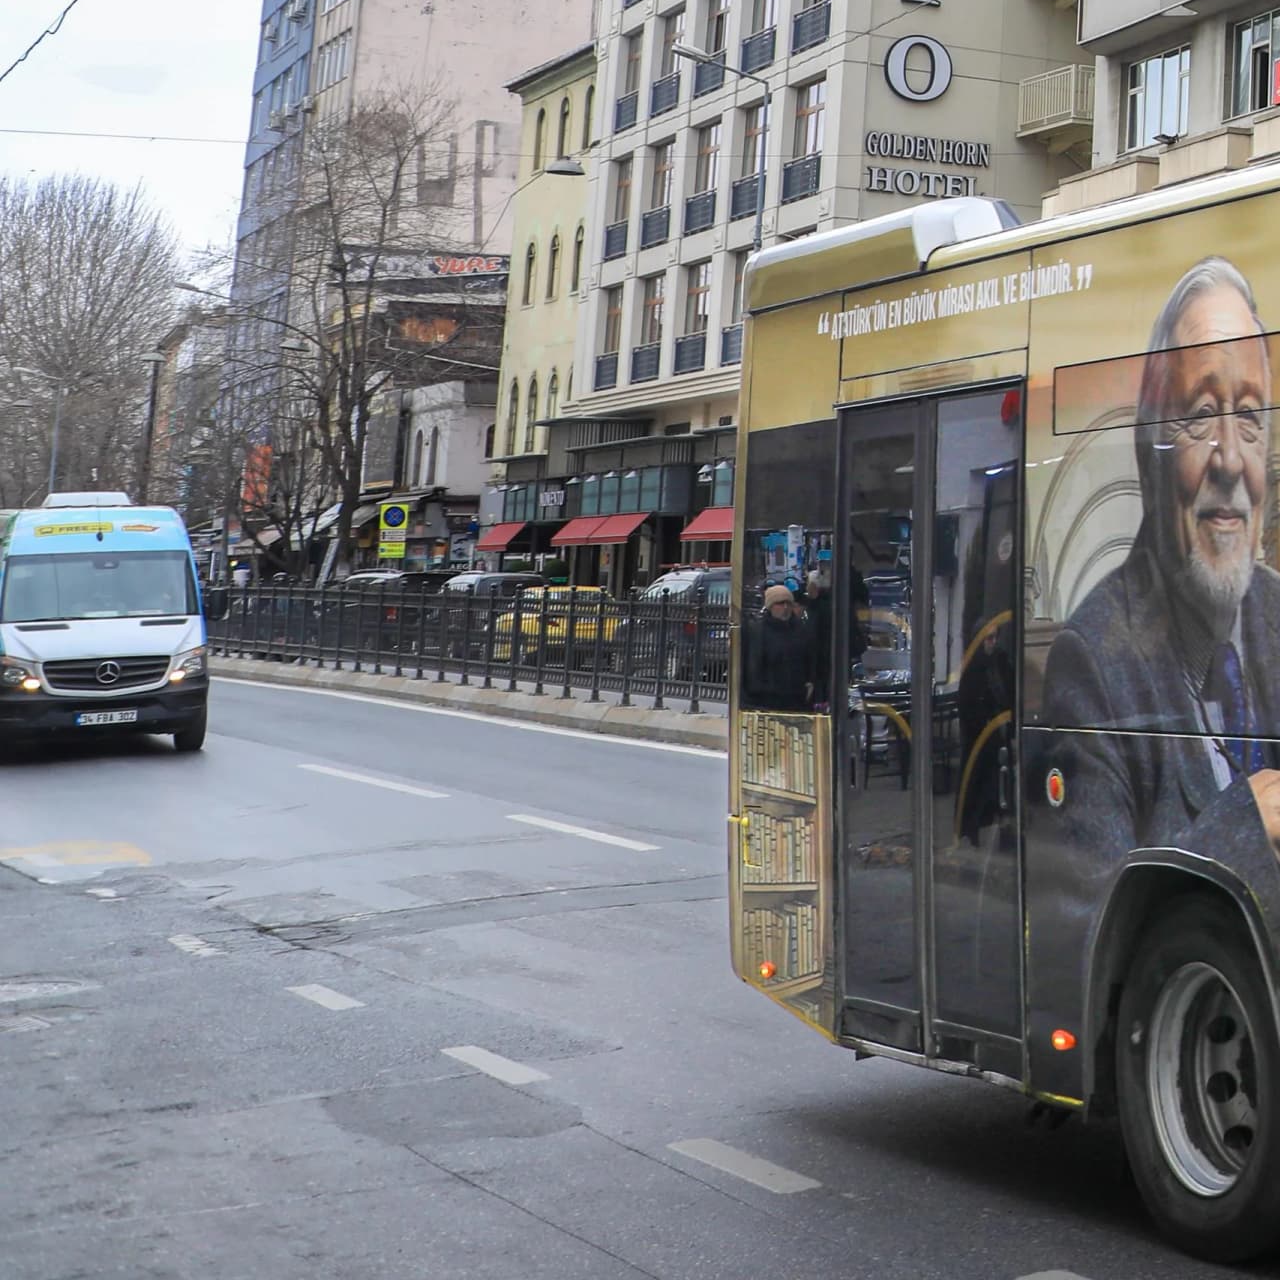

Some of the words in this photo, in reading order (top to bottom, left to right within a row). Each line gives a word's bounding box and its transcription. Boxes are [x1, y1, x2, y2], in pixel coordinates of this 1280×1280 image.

[866, 130, 937, 163] GOLDEN
[940, 139, 991, 168] HORN
[866, 166, 984, 199] HOTEL
[888, 299, 901, 329] EN
[903, 289, 936, 326] BÜYÜK
[937, 283, 975, 319] MİRASI
[975, 278, 1000, 310] AKIL
[1003, 273, 1018, 305] VE
